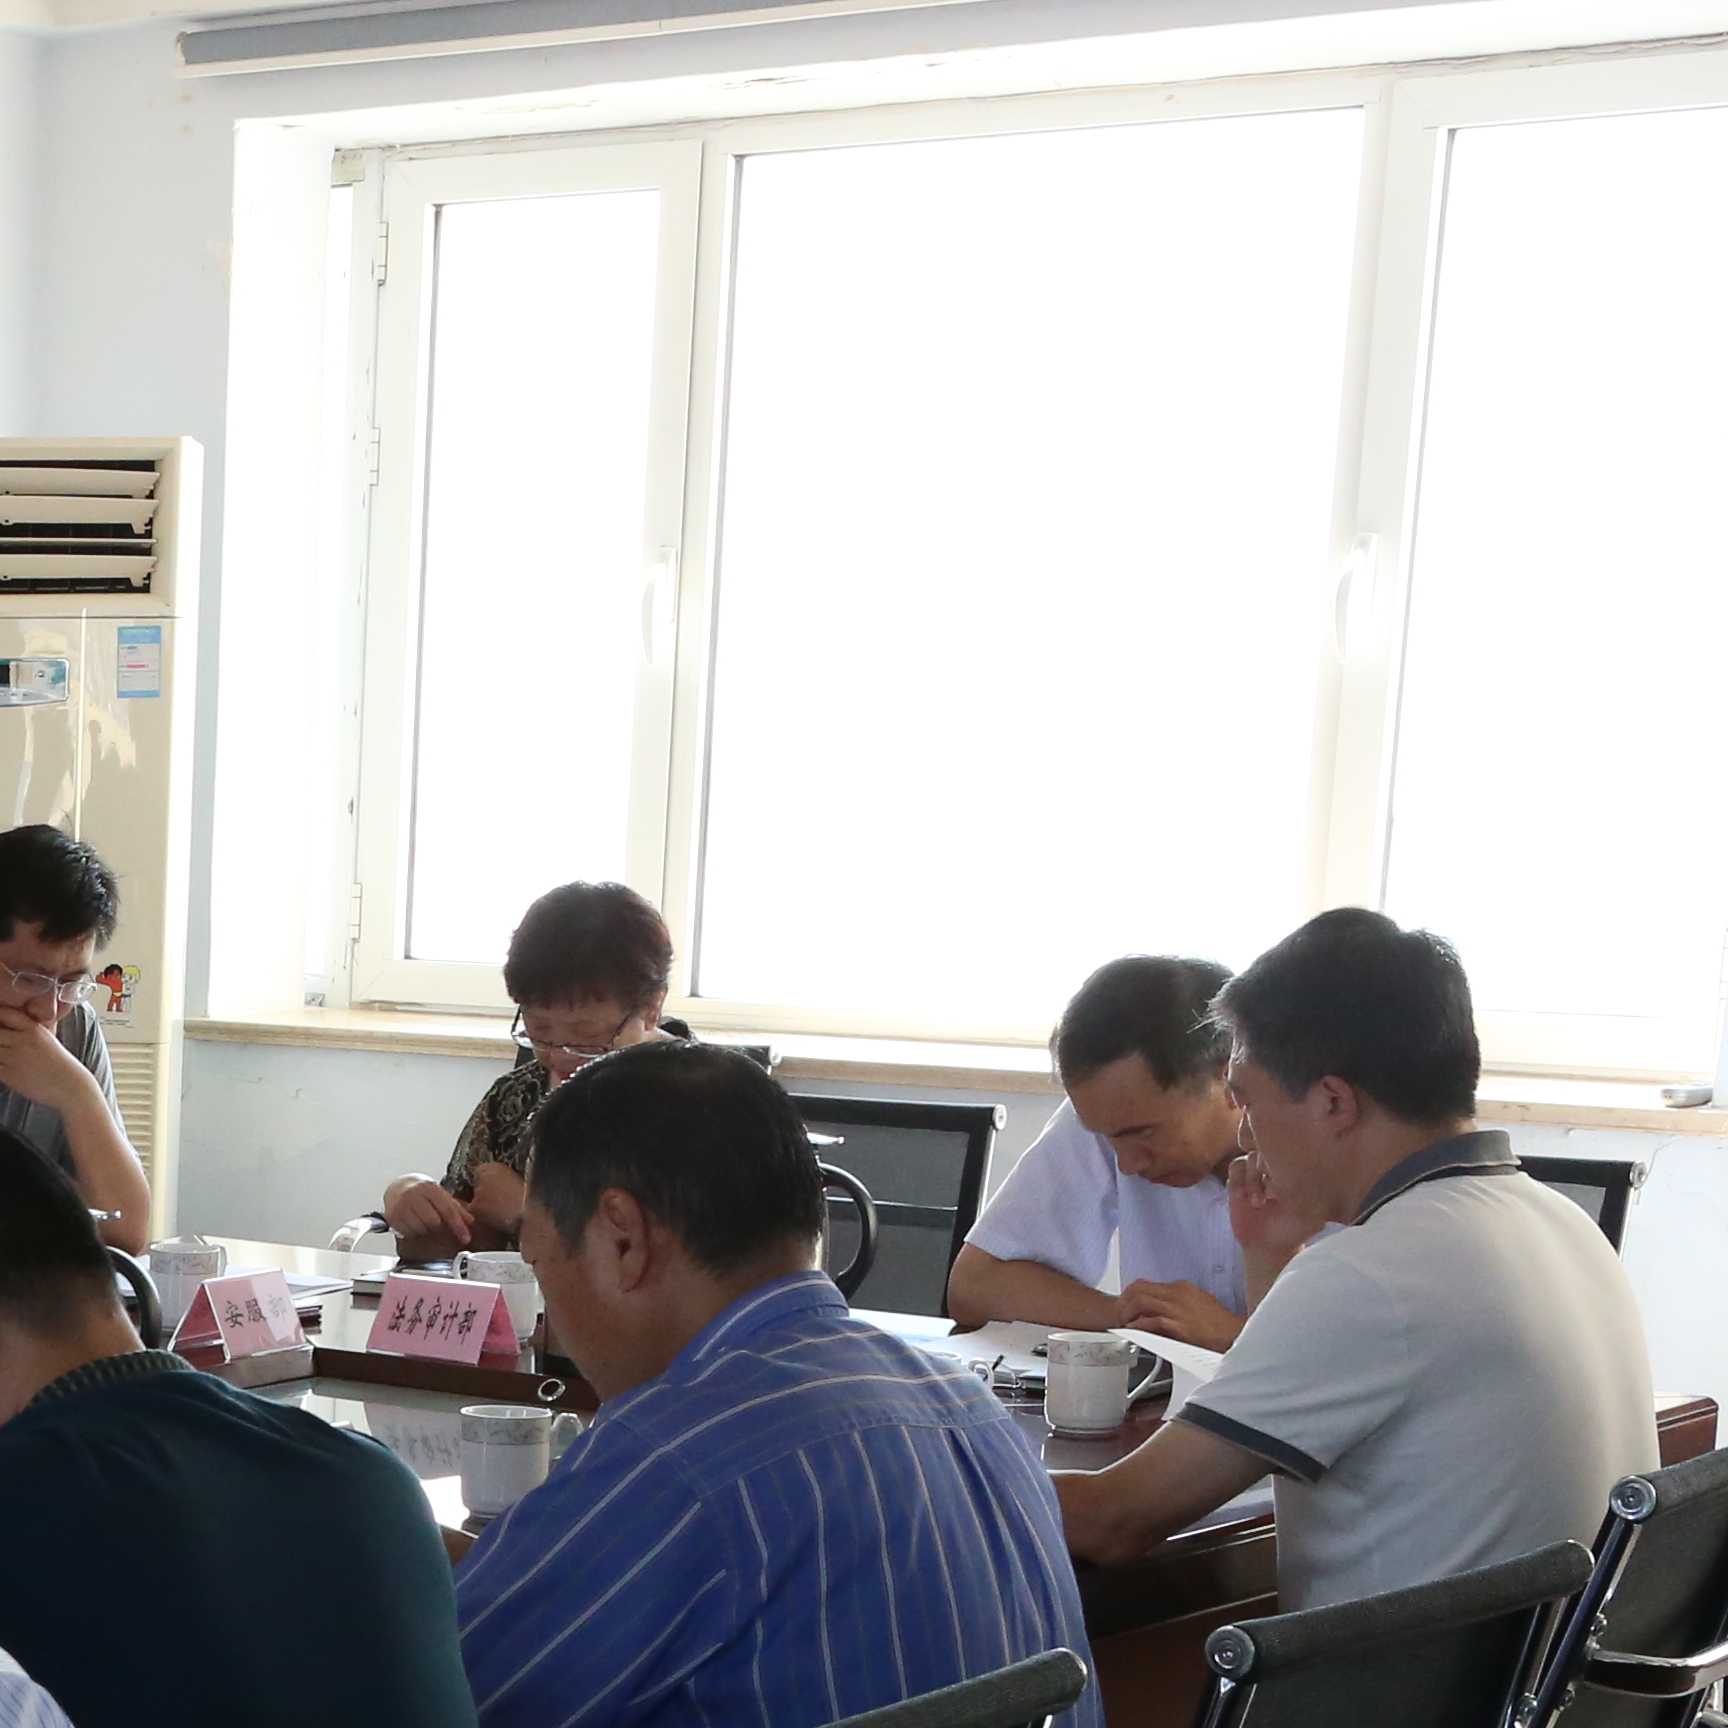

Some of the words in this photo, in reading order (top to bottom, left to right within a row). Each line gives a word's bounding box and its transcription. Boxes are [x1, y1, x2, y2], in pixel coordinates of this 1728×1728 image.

[388, 1295, 477, 1345] 法务审计部
